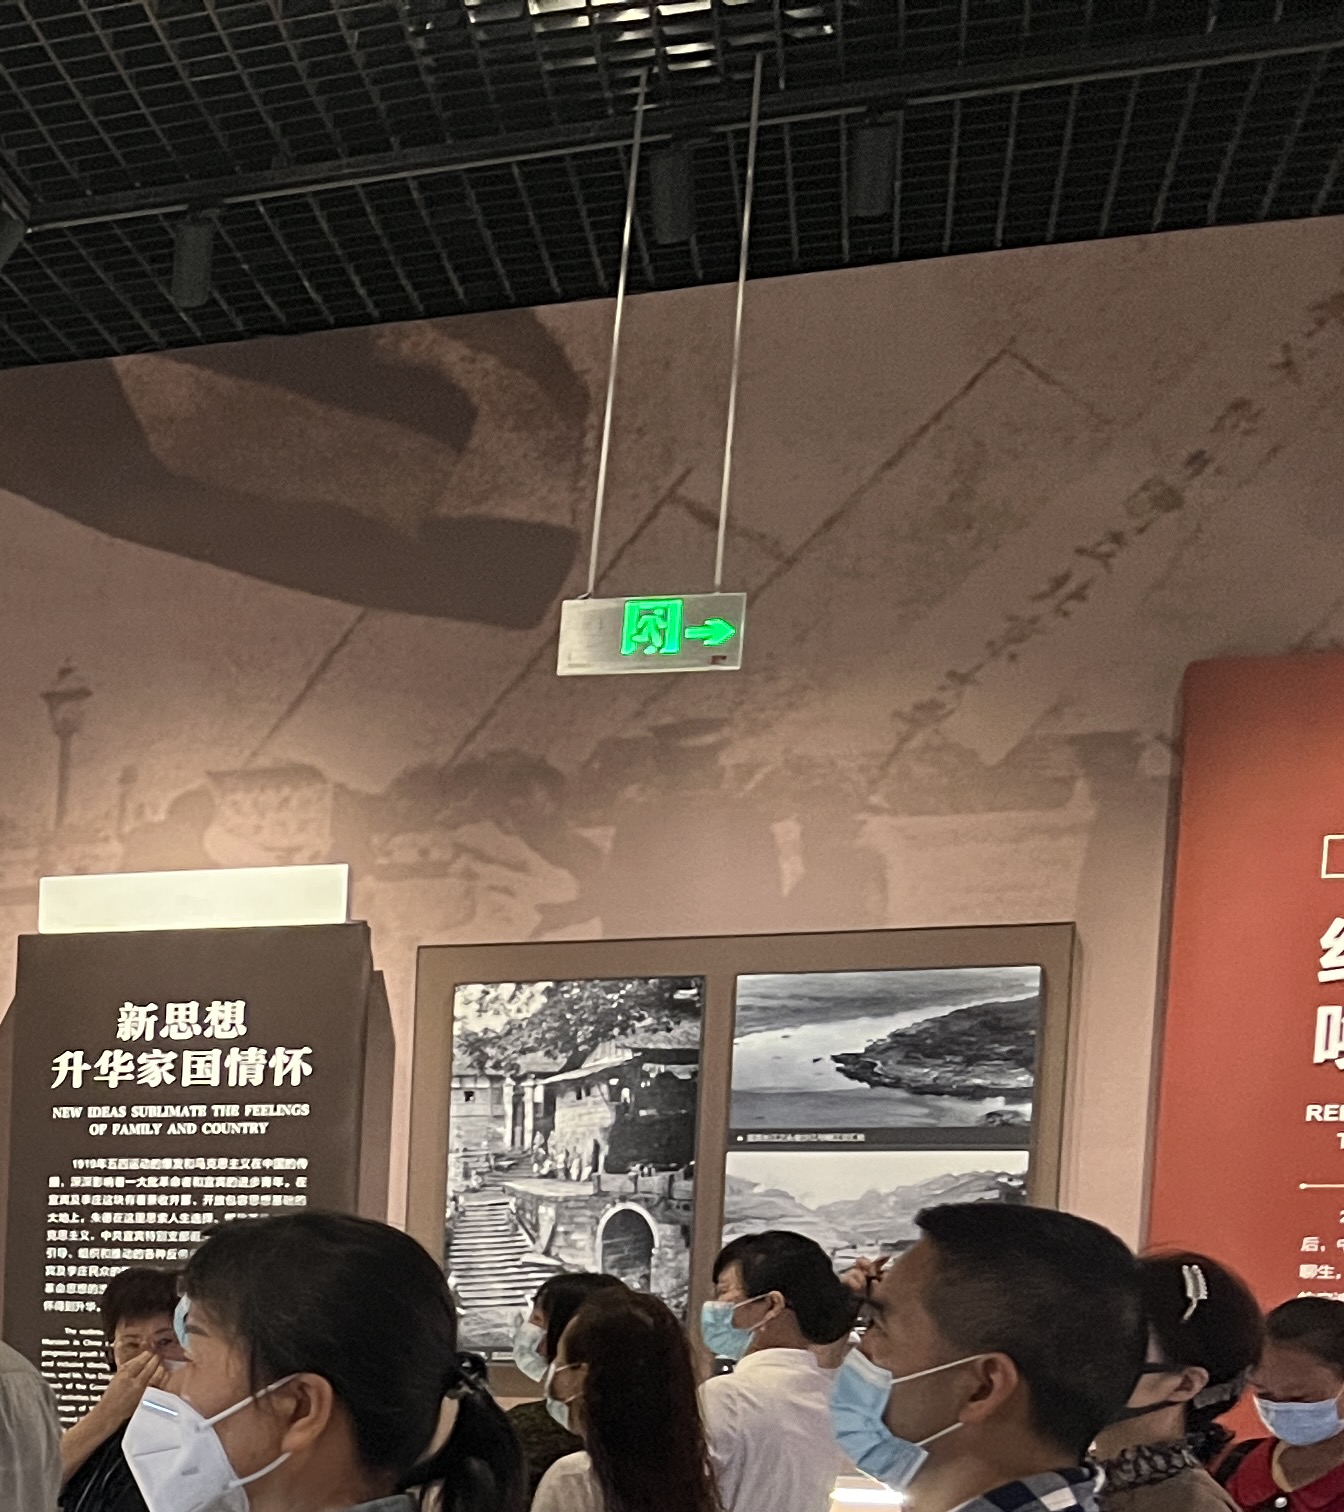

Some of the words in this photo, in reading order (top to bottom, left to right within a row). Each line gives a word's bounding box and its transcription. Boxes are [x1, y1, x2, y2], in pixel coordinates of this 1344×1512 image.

[116, 1000, 248, 1042] 新思想
[50, 1046, 313, 1089] 升华家国情怀
[52, 1106, 83, 1119] NEW
[87, 1105, 127, 1119] IDEAS
[130, 1105, 207, 1118] SUBLIMATE
[211, 1104, 240, 1118] THE
[244, 1103, 310, 1117] FEELINGS
[88, 1123, 108, 1136] OF
[111, 1123, 163, 1136] FAMILY
[166, 1122, 198, 1135] AND
[201, 1121, 270, 1135] COUNTRY
